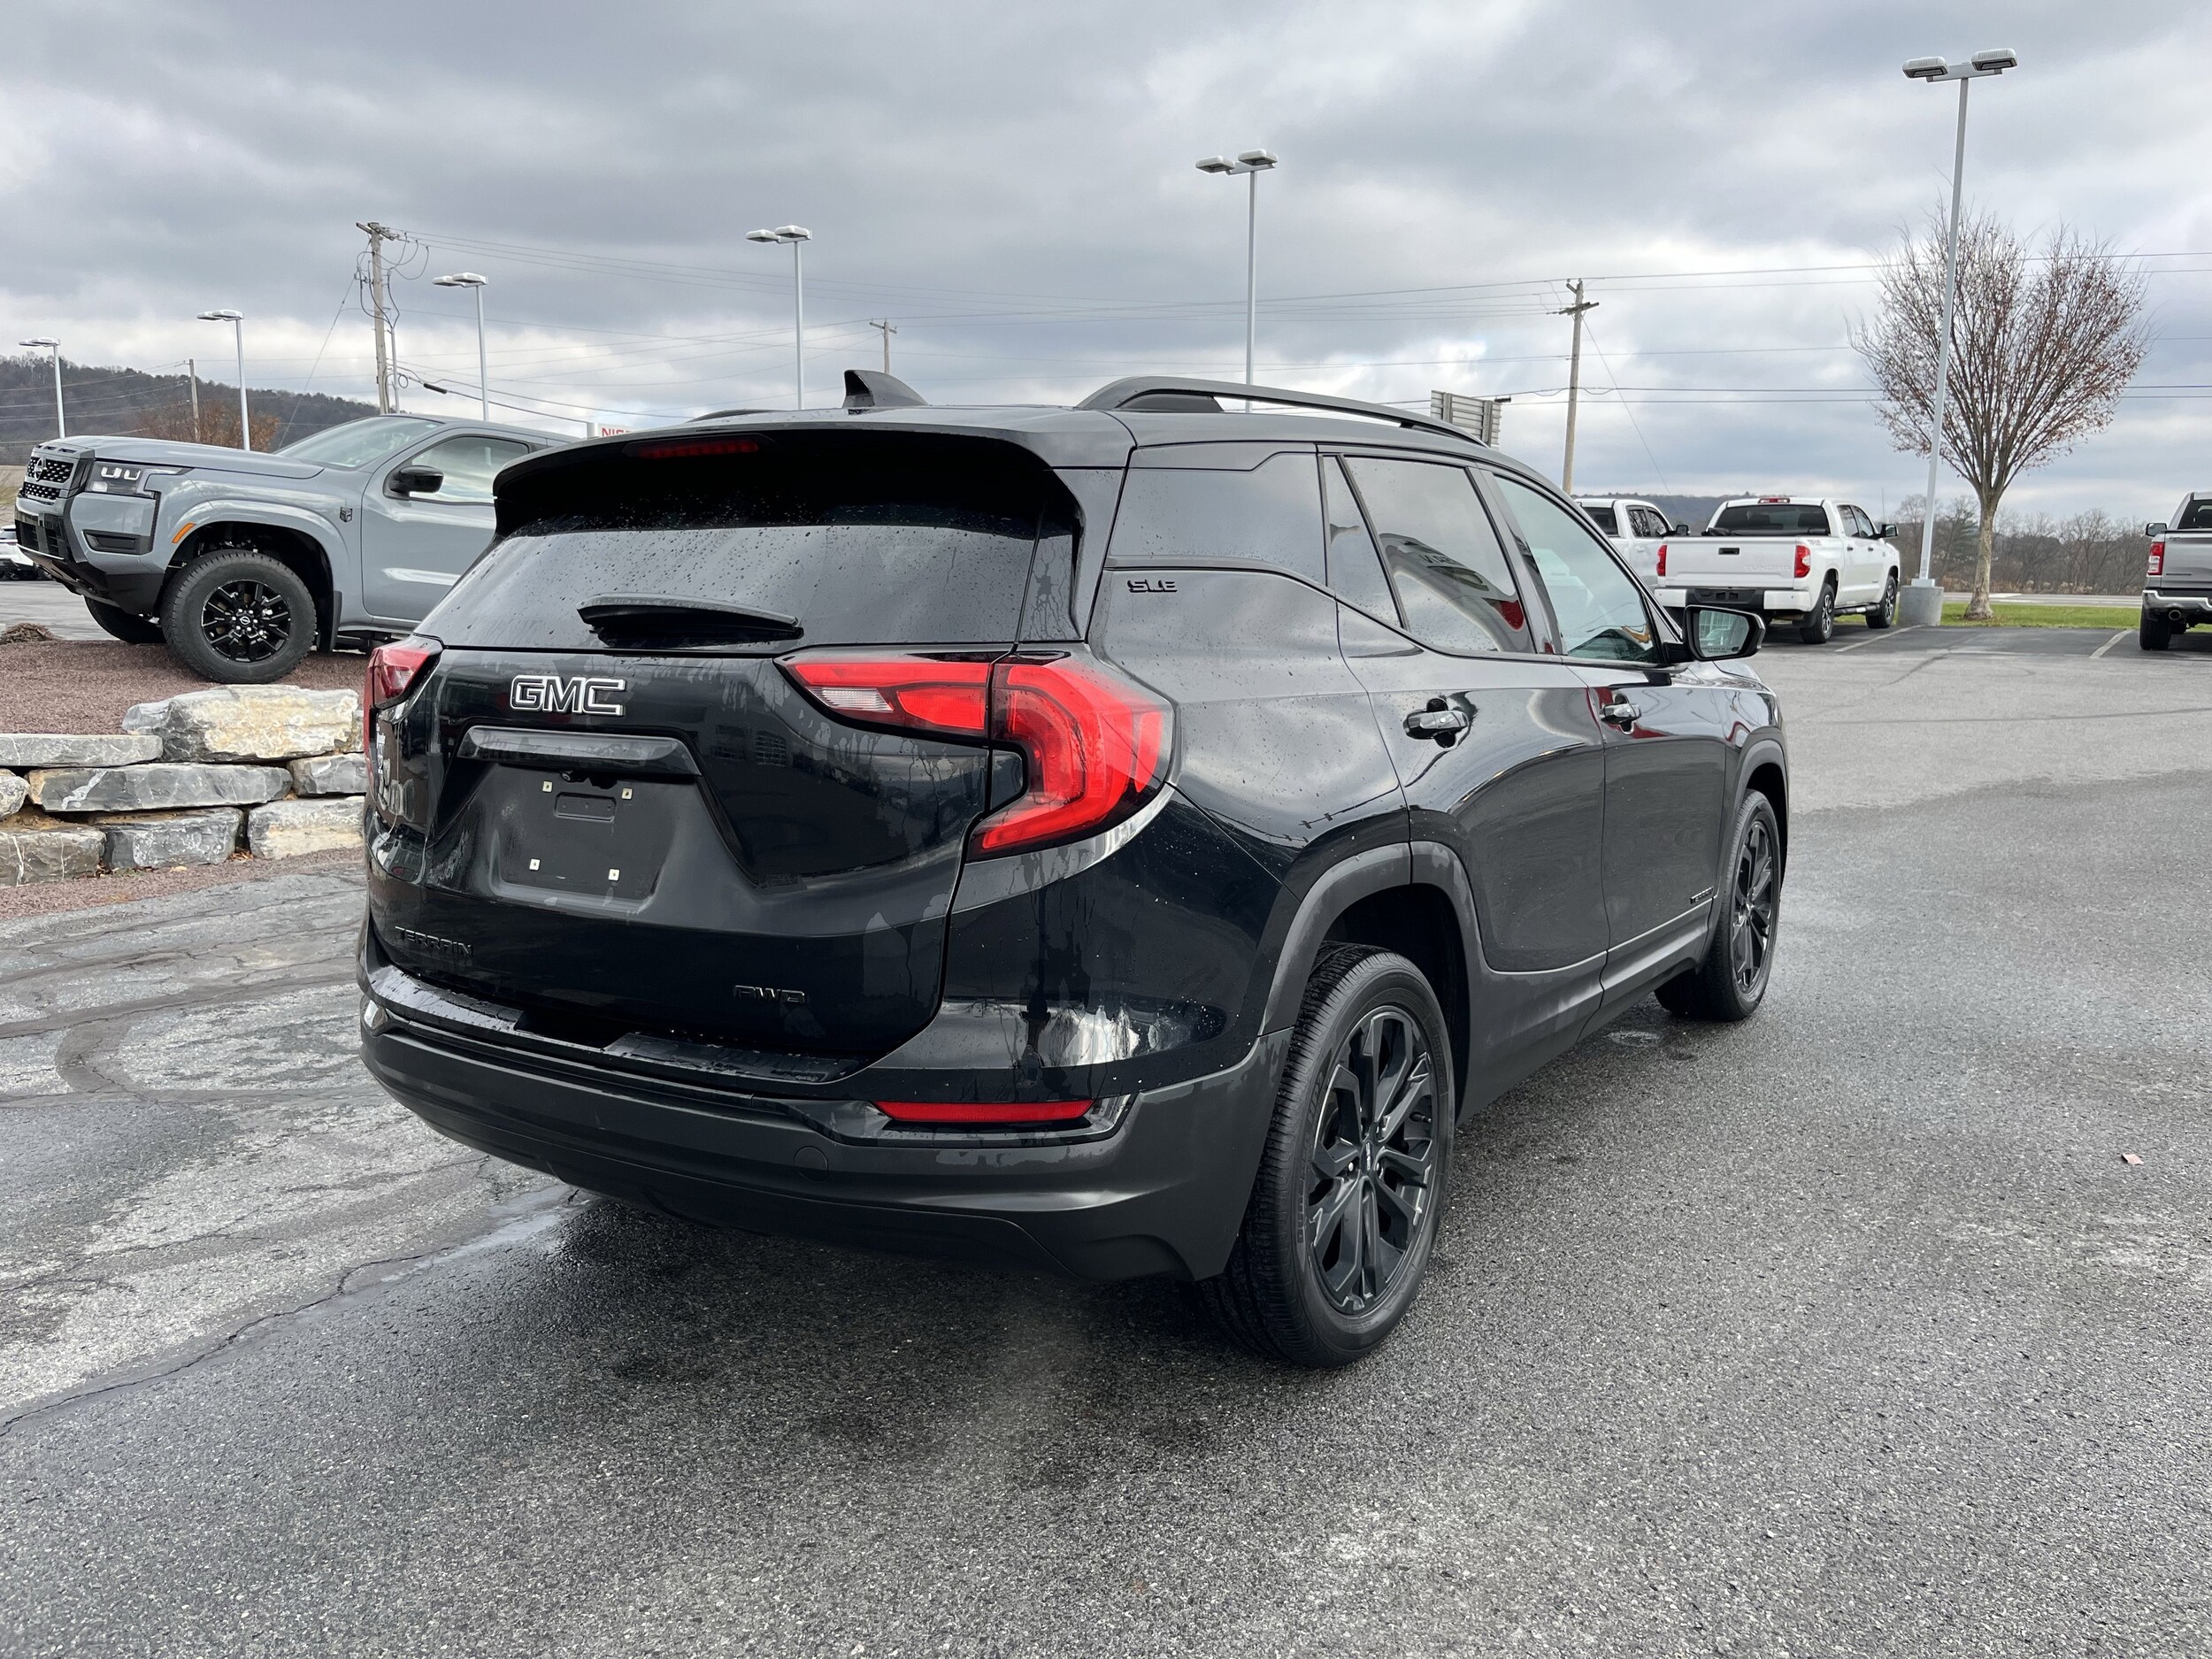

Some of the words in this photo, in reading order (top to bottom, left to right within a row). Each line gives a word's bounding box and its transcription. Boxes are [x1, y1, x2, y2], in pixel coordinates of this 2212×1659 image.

[1126, 579, 1178, 593] SLE
[510, 674, 626, 716] GMC
[395, 926, 473, 956] TERRAIN
[733, 985, 805, 1004] AWD
